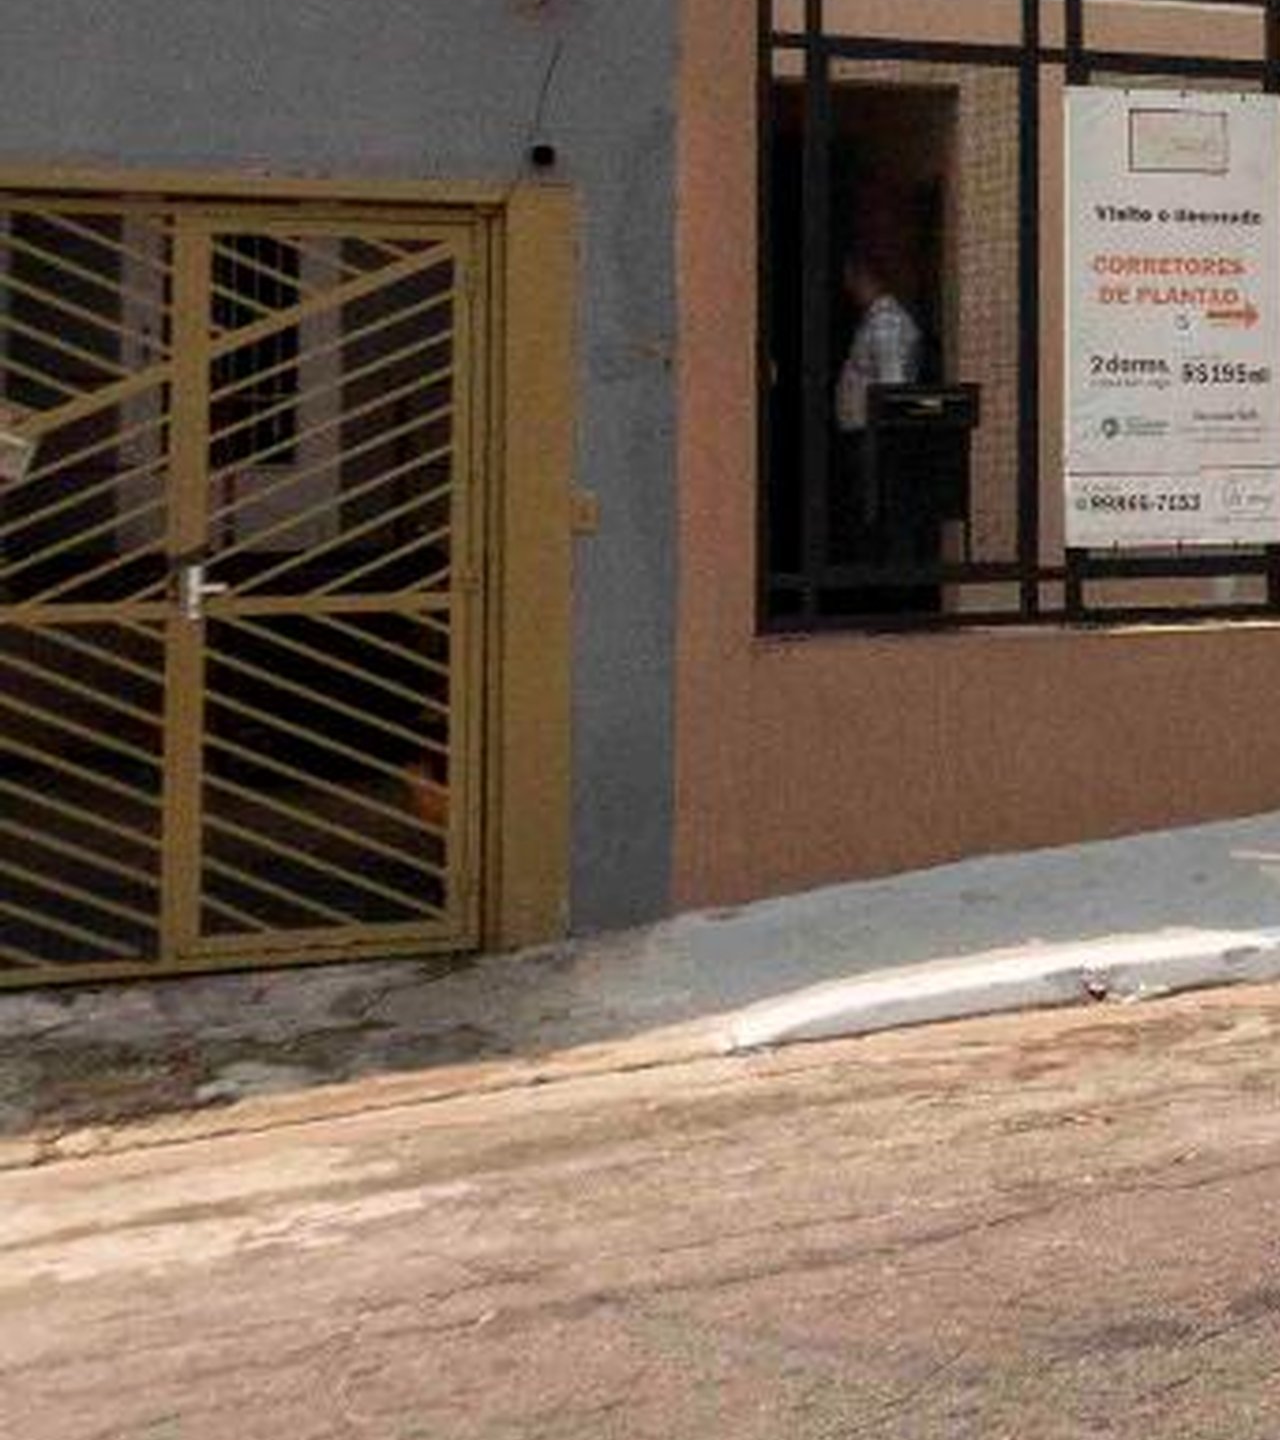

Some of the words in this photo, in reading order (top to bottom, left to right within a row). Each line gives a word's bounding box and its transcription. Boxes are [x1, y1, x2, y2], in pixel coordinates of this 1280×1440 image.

[1093, 254, 1246, 277] CORRETORES
[1099, 286, 1128, 305] DE
[1090, 355, 1103, 374] 2
